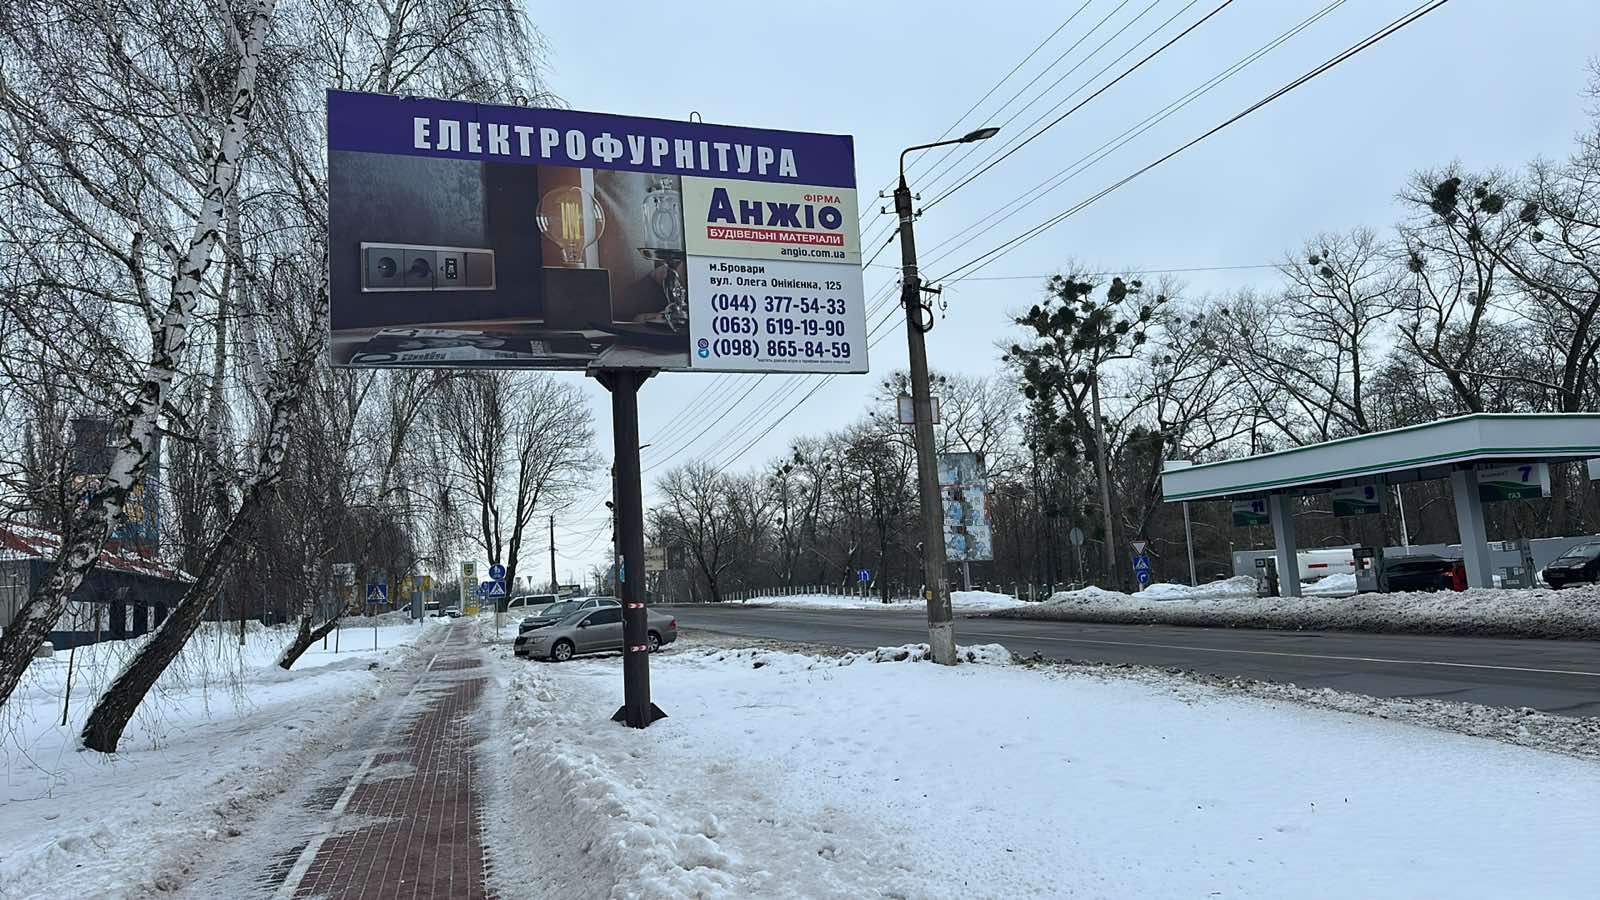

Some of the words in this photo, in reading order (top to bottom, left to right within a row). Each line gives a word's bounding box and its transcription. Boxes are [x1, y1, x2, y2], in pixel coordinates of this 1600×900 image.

[413, 117, 798, 178] ЕЛЕКТРОФУРНІТУРА
[803, 193, 842, 204] ФІРМА
[710, 228, 777, 241] БУДІВЕЛЬНІ
[779, 232, 841, 244] МАТЕРІАЛИ
[780, 247, 846, 259] angio.com.ua
[709, 263, 765, 274] м.Бровари
[710, 277, 733, 287] вул.
[736, 277, 767, 287] Олега
[771, 279, 822, 291] Онікієнка,
[824, 281, 842, 290] 125
[711, 294, 757, 314] (044)
[764, 295, 846, 315] 377-54-33
[712, 316, 759, 336] (063)
[766, 318, 845, 337] 619-19-90
[713, 339, 760, 358] (098)
[767, 340, 851, 358] 865-84-59
[1517, 465, 1532, 482] 7
